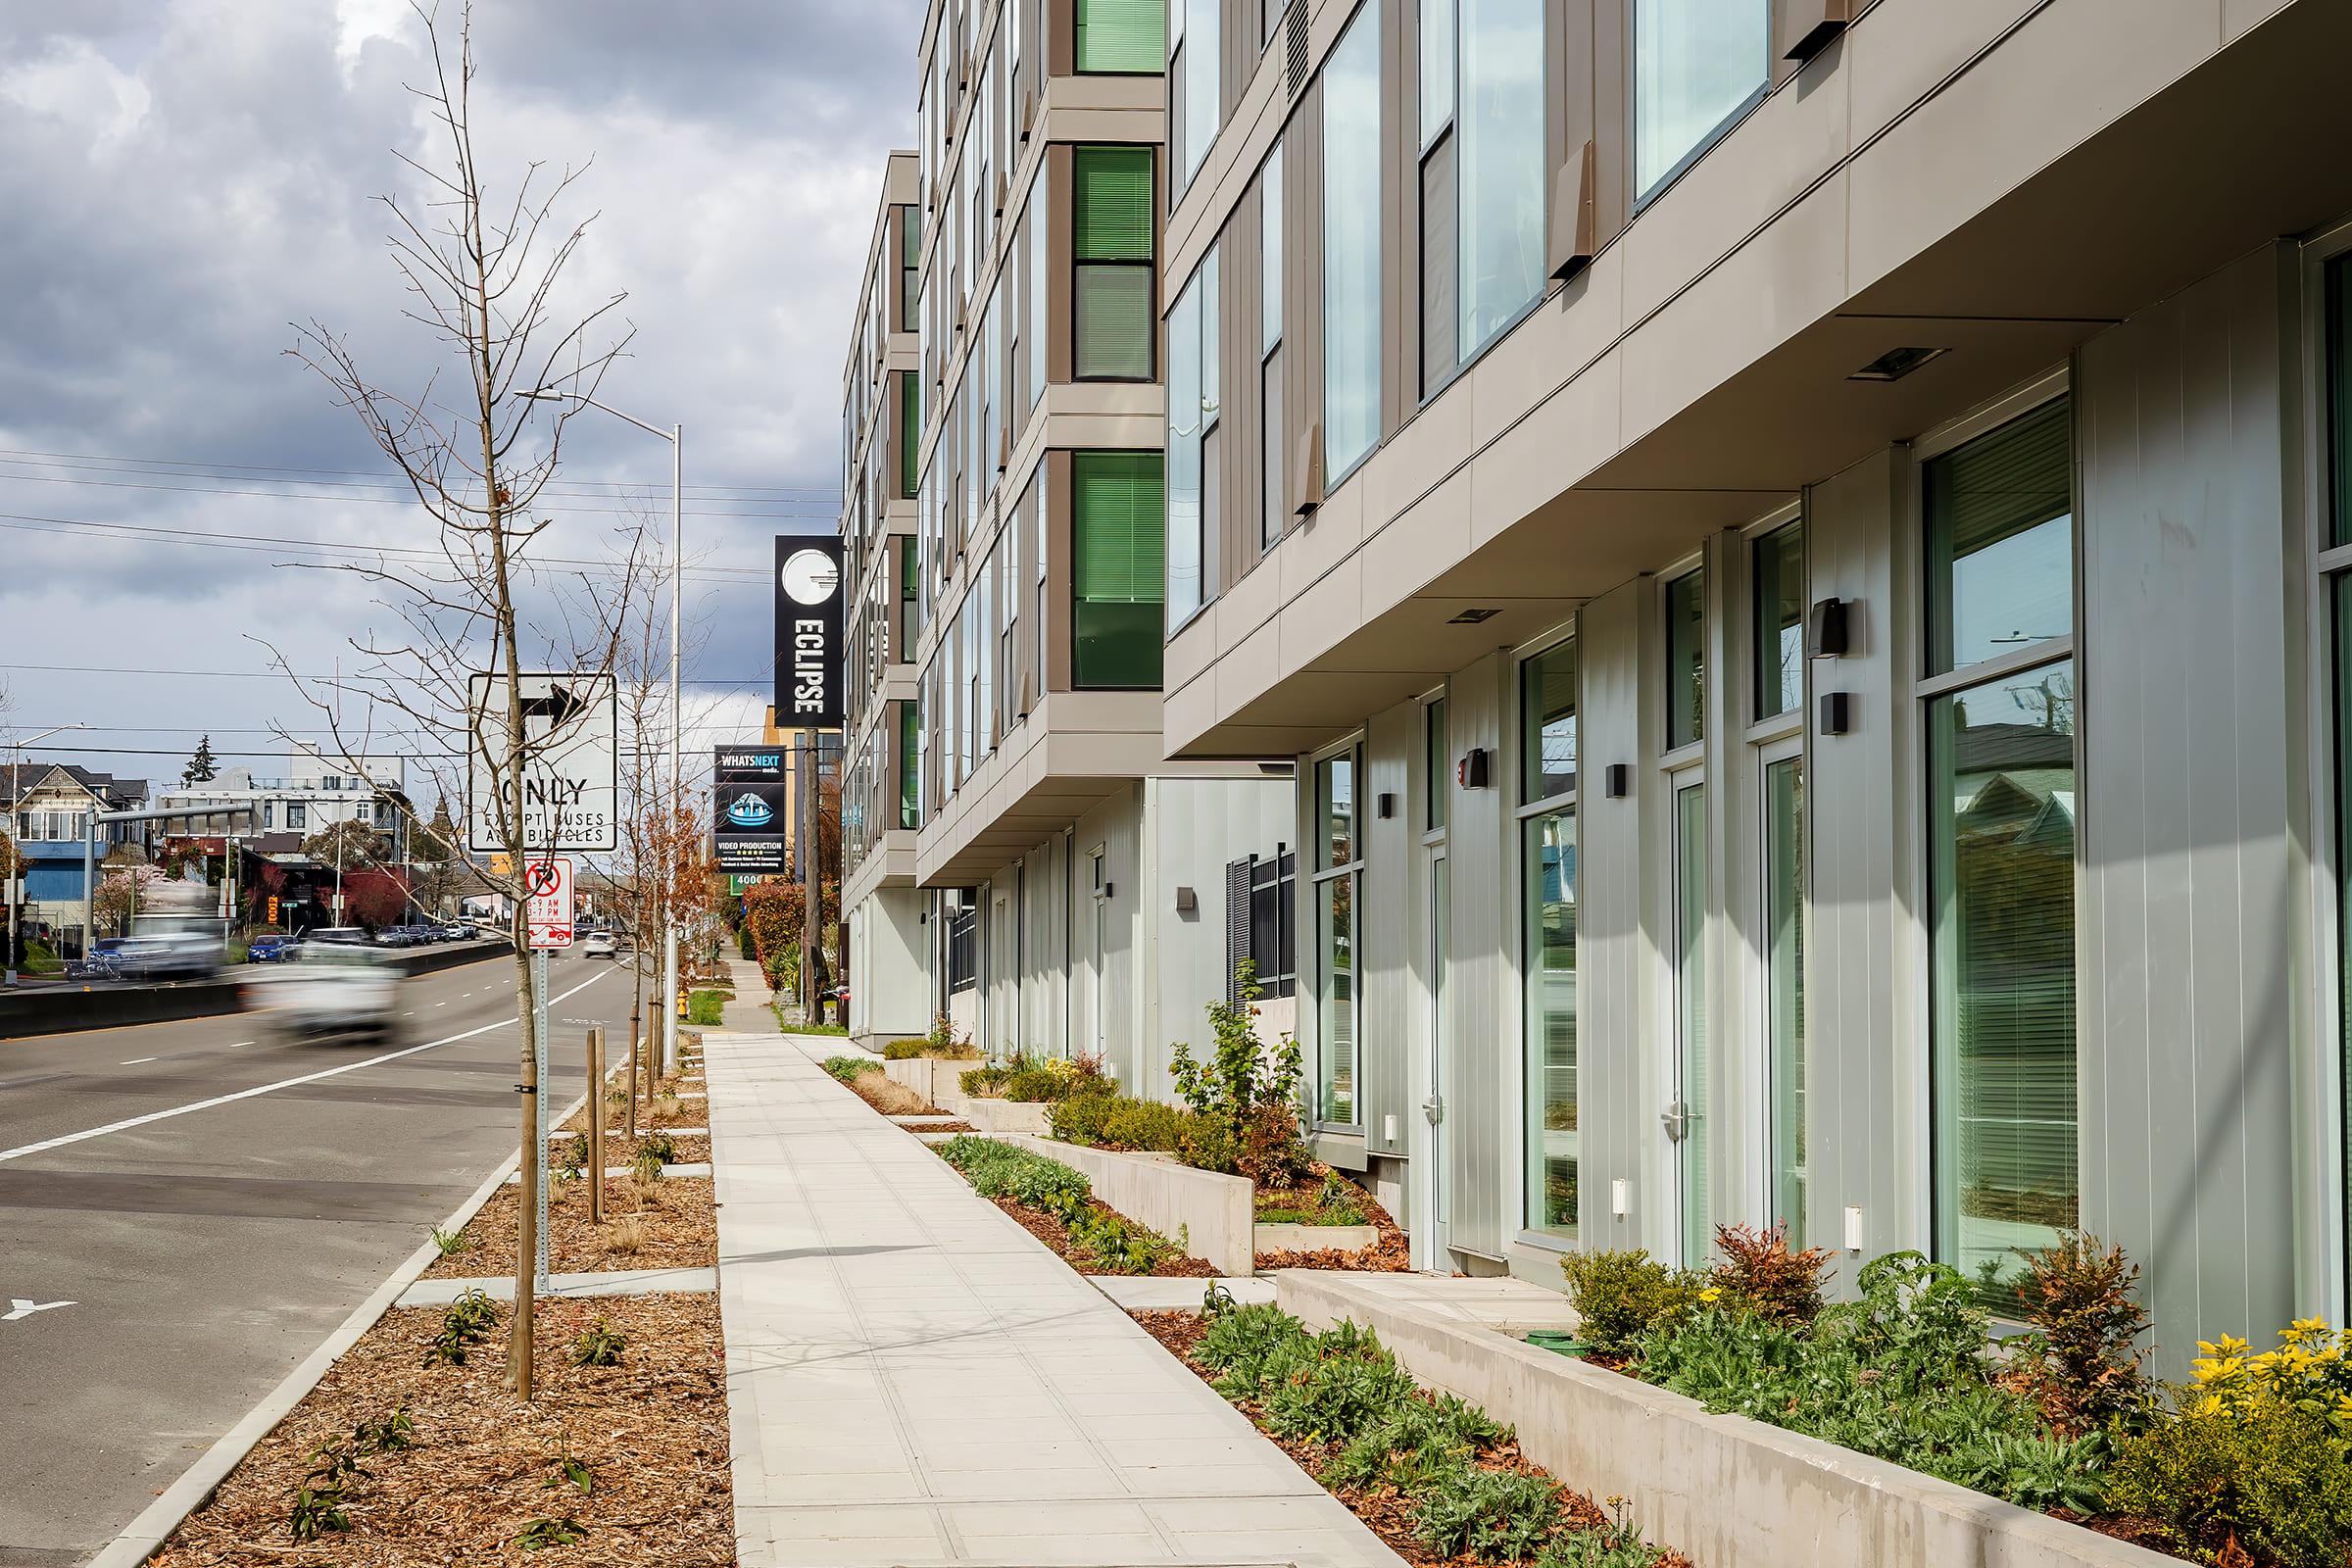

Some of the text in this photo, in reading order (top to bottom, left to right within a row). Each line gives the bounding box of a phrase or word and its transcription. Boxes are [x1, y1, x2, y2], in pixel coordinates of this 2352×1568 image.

[795, 619, 824, 713] ECLIPSE
[721, 755, 780, 766] WHATSNEXT
[485, 813, 604, 826] EXCPT BUSES
[528, 829, 603, 842] BICYCLES
[547, 899, 559, 907] AM
